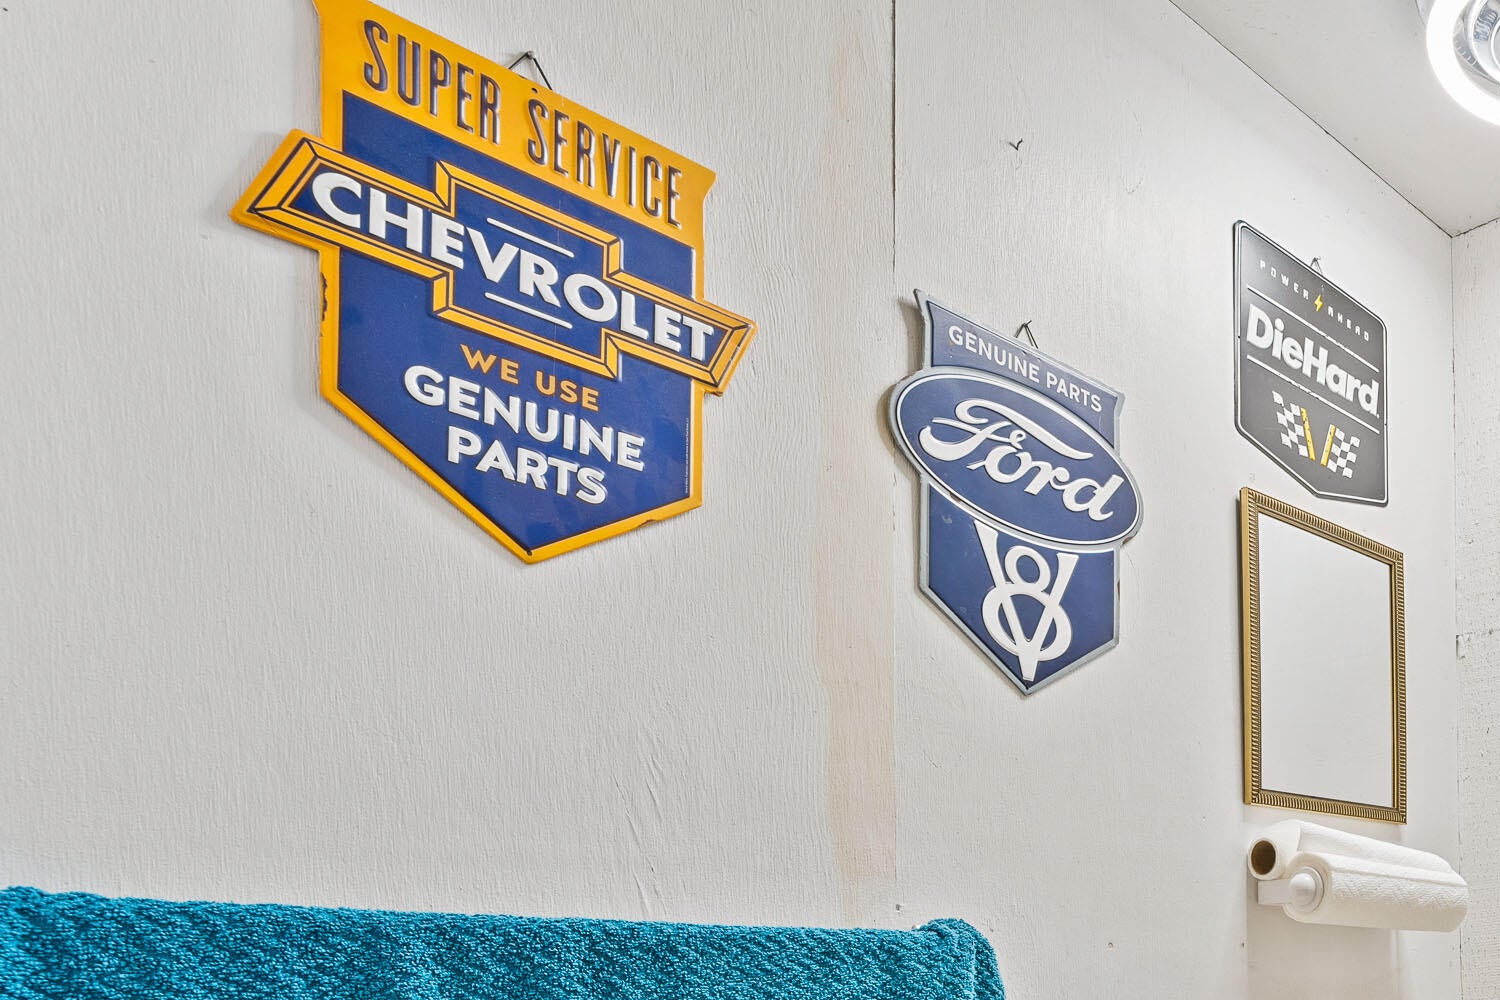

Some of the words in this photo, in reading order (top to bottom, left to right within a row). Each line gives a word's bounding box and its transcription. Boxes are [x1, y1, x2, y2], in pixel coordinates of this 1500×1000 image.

[363, 19, 501, 144] SUPER
[527, 98, 683, 230] SERVICE
[311, 171, 714, 362] CHEVROLET
[1260, 259, 1309, 300] POWER
[1327, 305, 1369, 342] AHEAD
[460, 343, 520, 381] WE
[536, 370, 600, 412] USE
[948, 325, 1041, 383] GENUINE
[1046, 371, 1103, 413] PARTS
[404, 365, 645, 472] GENUINE
[446, 425, 608, 505] PARTS
[919, 398, 1125, 521] Ford
